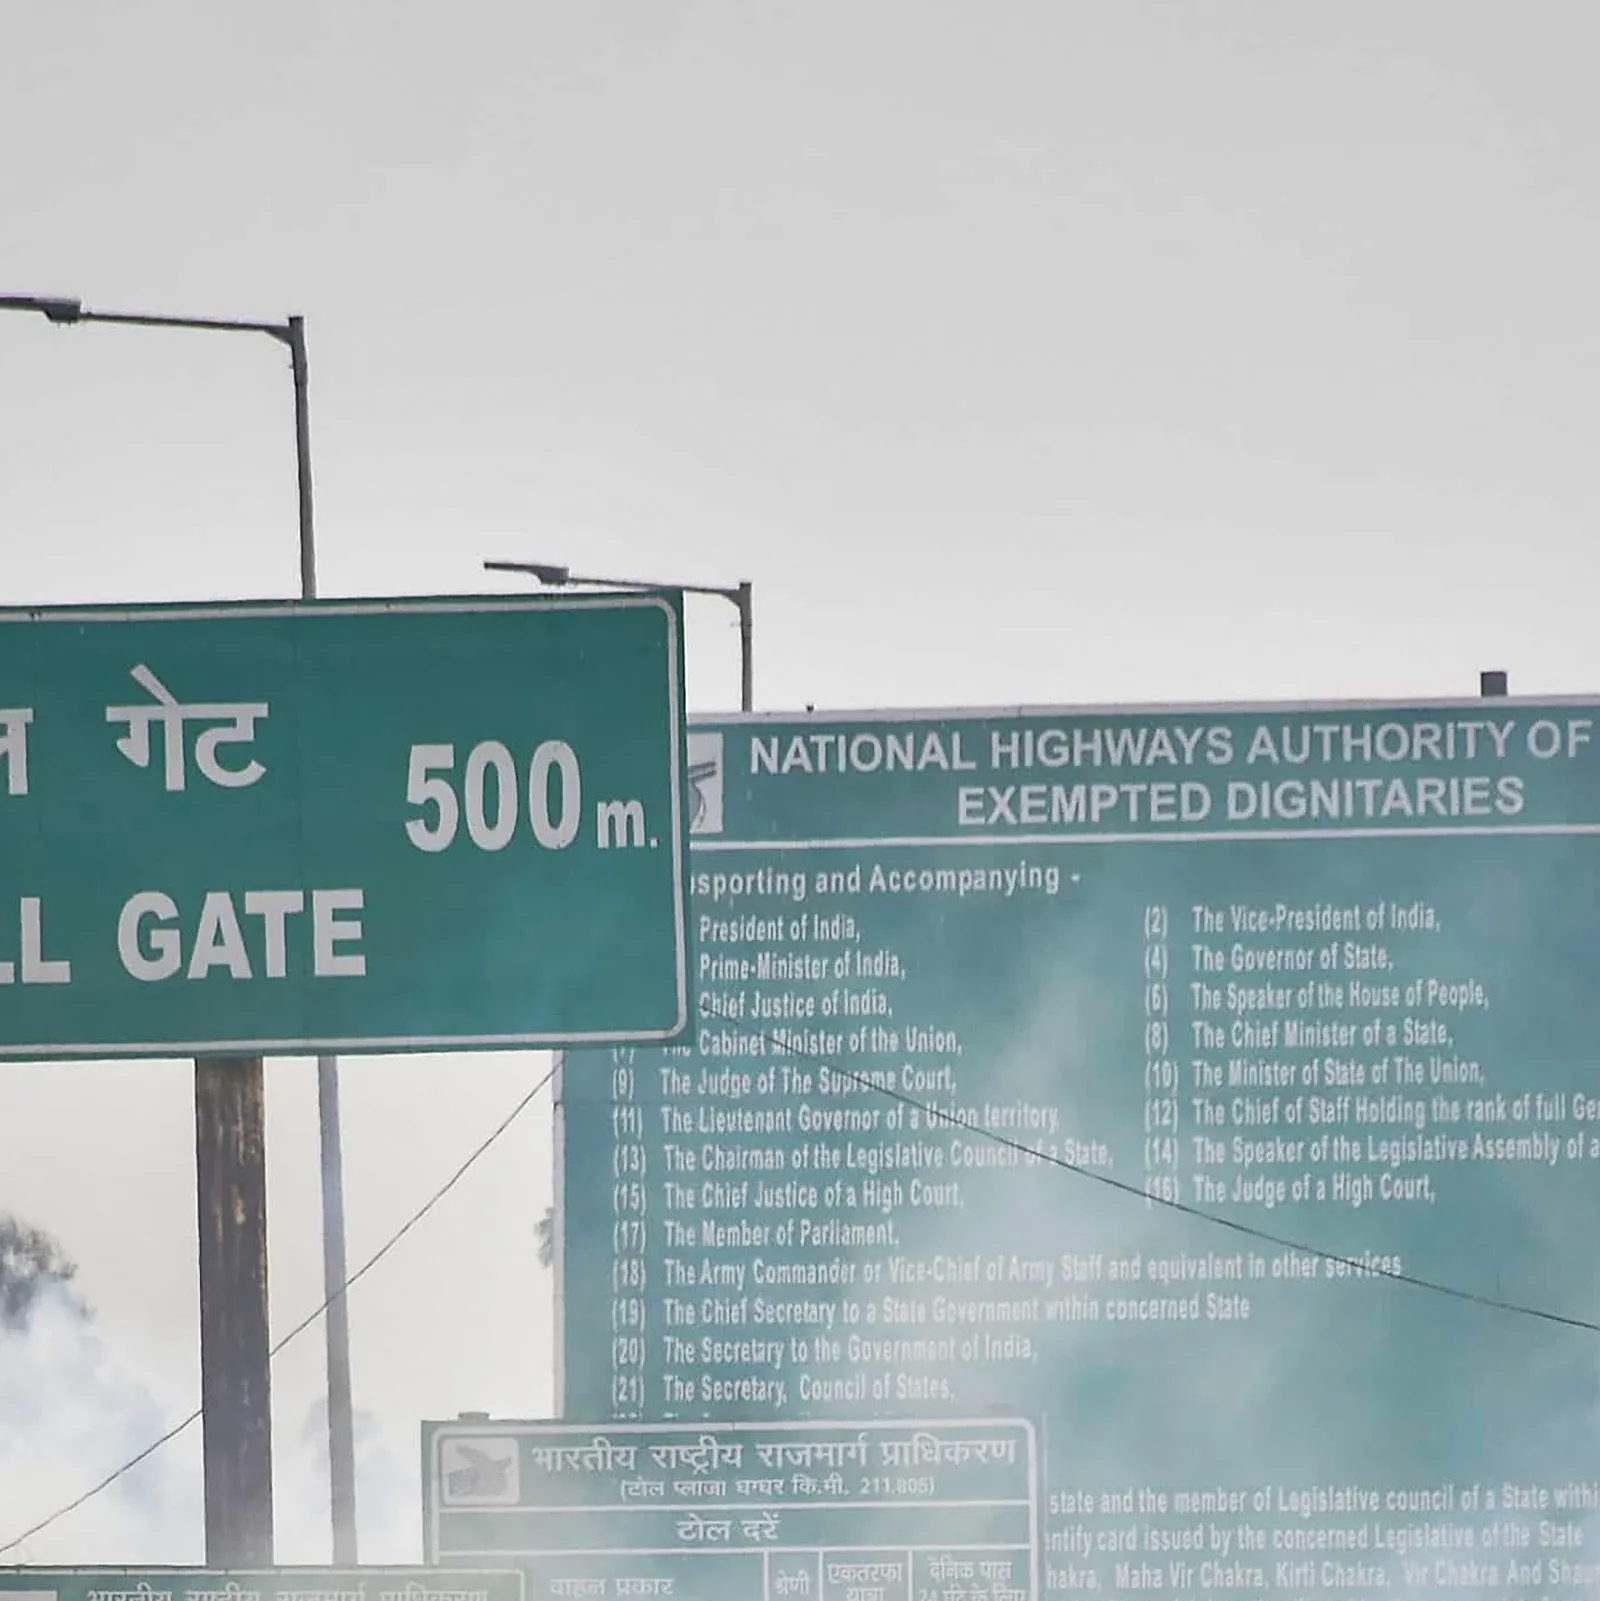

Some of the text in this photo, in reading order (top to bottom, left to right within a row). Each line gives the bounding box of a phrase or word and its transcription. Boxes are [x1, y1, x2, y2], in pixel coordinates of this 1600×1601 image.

[105, 663, 268, 793] गेट
[749, 733, 977, 777] NATIONAL
[989, 726, 1235, 772] HIGHWAYS
[1247, 721, 1517, 765] AUTHORITY
[1527, 719, 1593, 760] OF
[405, 740, 581, 853] 500
[957, 775, 1524, 826] EXEMPTED DIGNITARIES
[691, 860, 1060, 900] sporting and Accompanying
[117, 888, 367, 983] GATE
[700, 913, 860, 943] President of India,
[1145, 901, 1440, 940] (2) The Vice-President of India,
[699, 948, 905, 981] Prime-Minister of India,
[1145, 941, 1393, 980] (4) The Governor of State,
[697, 988, 892, 1019] Chief Justice of India,
[1145, 978, 1489, 1016] (6) The Speaker of the House of People,
[698, 1028, 766, 1056] Cabinet
[771, 1028, 843, 1056] Minister
[849, 1025, 868, 1052] of
[871, 1025, 899, 1052] the
[902, 1025, 961, 1054] Union,
[1145, 1016, 1453, 1055] (8) The Chief Minister of a State,
[613, 1062, 956, 1101] (9) The Judge of The Supreme Court,
[613, 1180, 966, 1215] (15) The Chief Justice of a High Court,
[1193, 1174, 1226, 1209] The
[1232, 1174, 1285, 1208] Judge
[1292, 1173, 1311, 1201] of
[1316, 1180, 1326, 1200] a
[1332, 1172, 1373, 1207] High
[1379, 1172, 1436, 1202] Court,
[533, 1432, 1016, 1475] भारतीय राष्ट्रीय राजमार्ग प्राधिकरण
[676, 1512, 732, 1543] टोल
